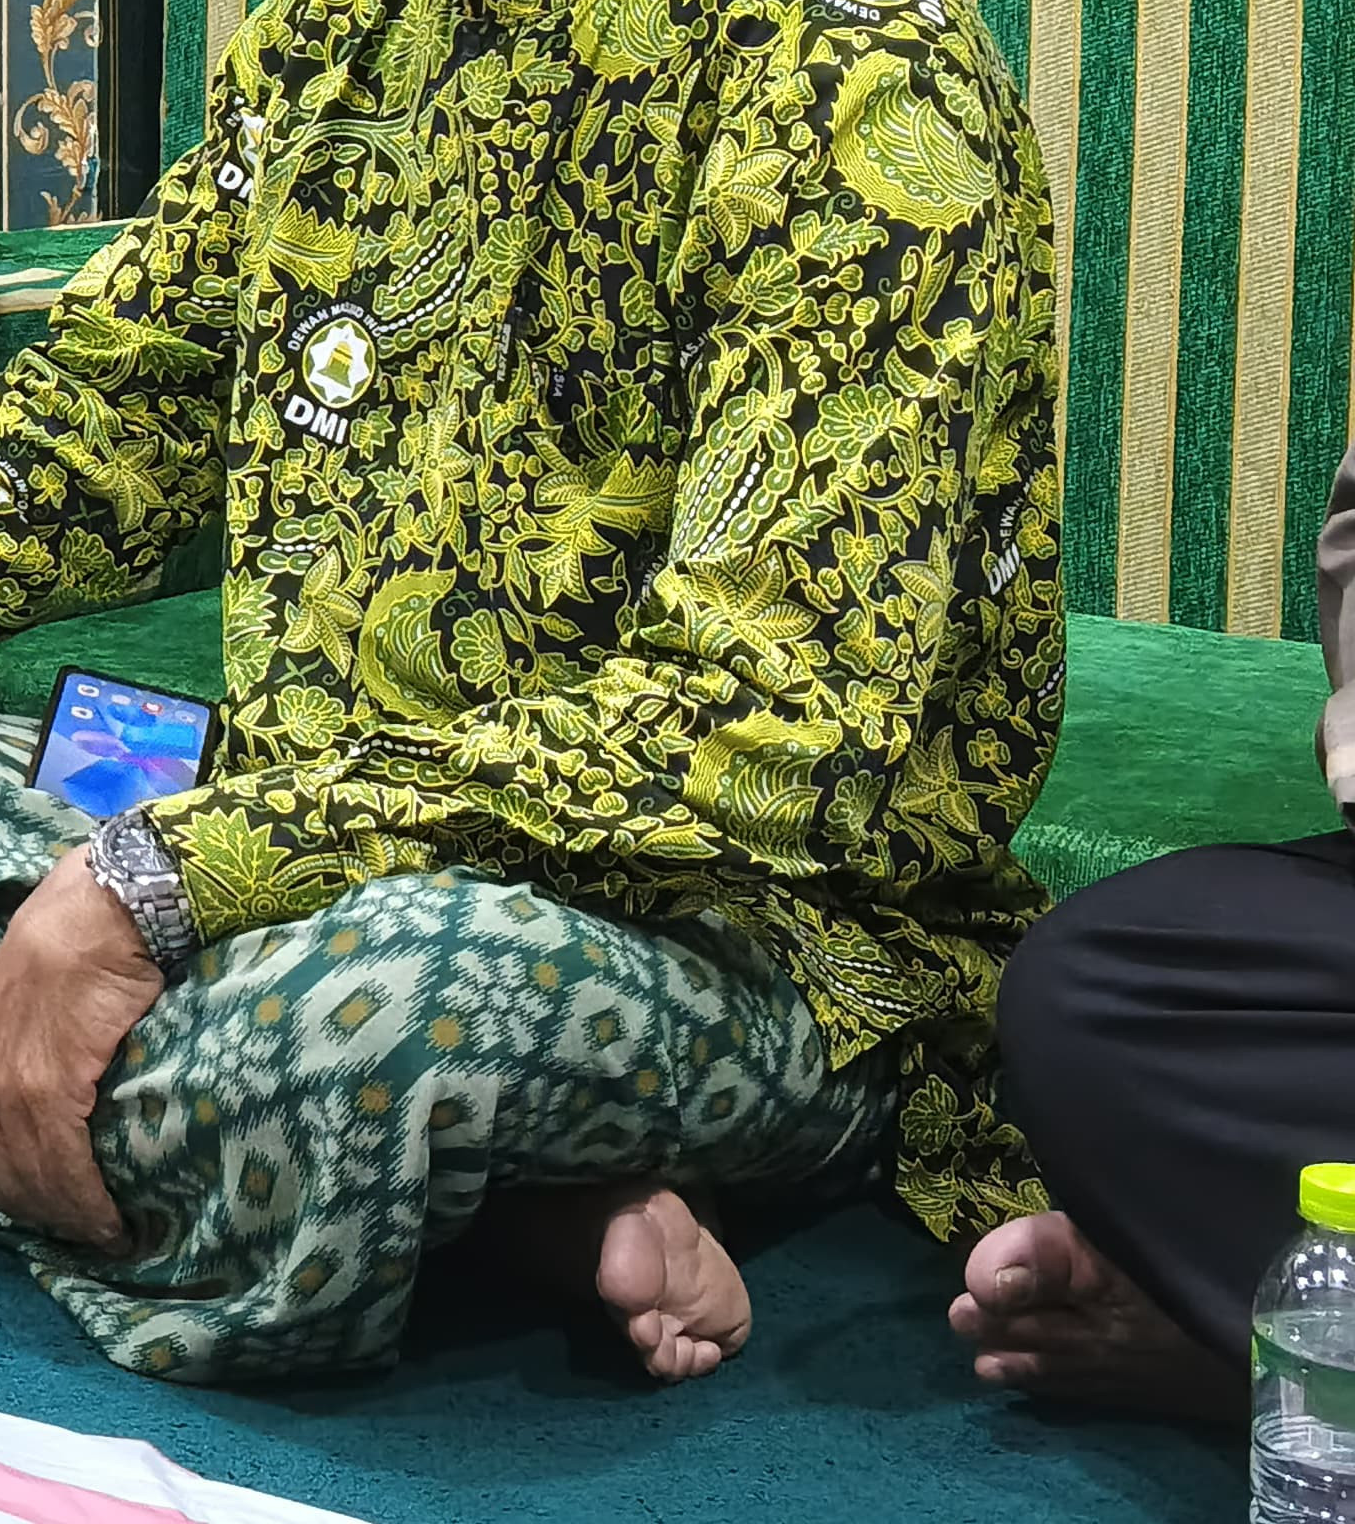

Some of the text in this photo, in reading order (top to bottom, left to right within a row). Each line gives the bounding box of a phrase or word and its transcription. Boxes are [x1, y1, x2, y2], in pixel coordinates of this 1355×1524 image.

[287, 308, 329, 351] DEWAN
[283, 394, 349, 445] DMI
[989, 542, 1021, 595] DMI
